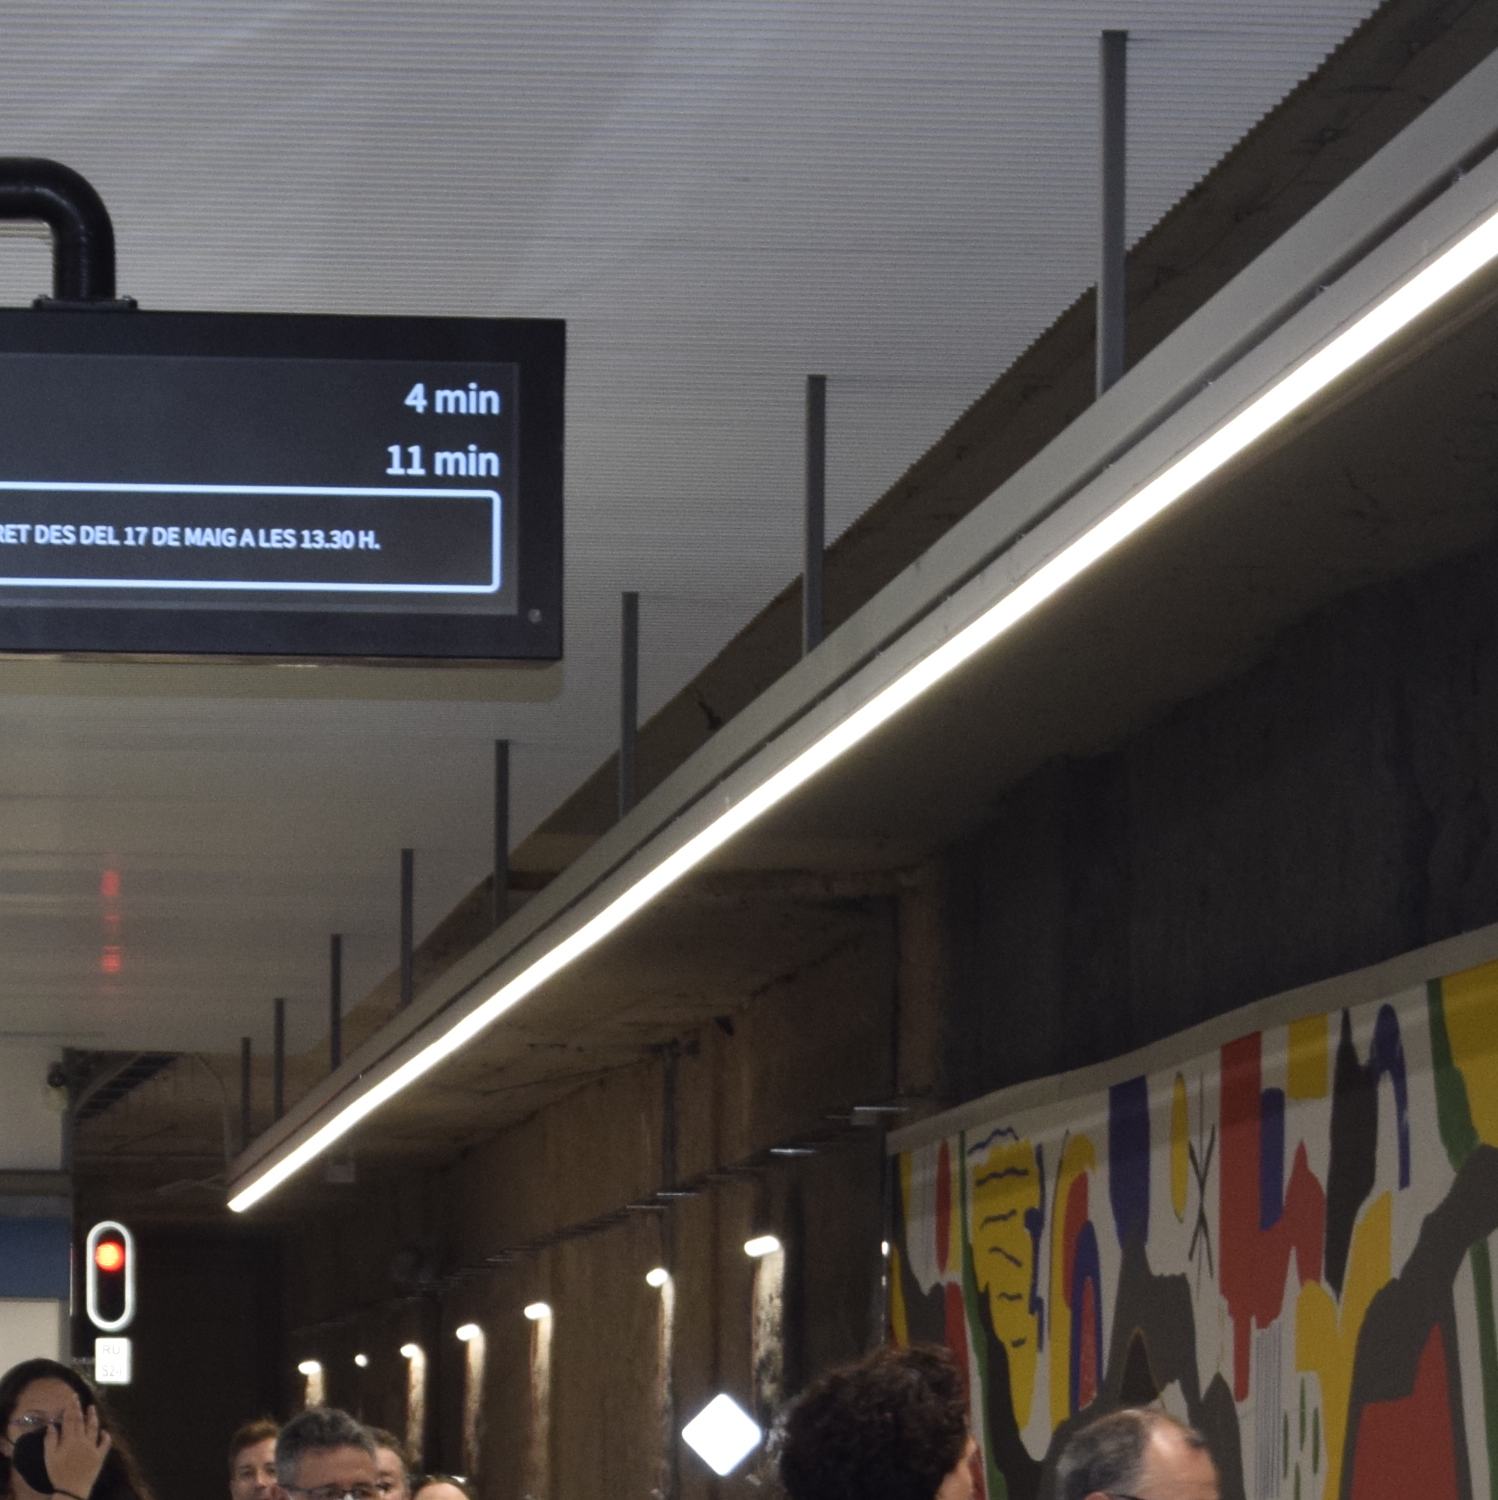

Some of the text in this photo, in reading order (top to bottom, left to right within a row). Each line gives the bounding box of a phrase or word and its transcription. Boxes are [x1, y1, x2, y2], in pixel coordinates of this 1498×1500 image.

[403, 381, 501, 415] 4 min
[385, 443, 501, 477] 11 min
[34, 524, 78, 546] DES
[80, 524, 120, 547] DEL
[123, 526, 149, 547] 17
[151, 526, 181, 548] DE
[184, 527, 238, 549] MAIG
[239, 528, 257, 548] A
[259, 528, 298, 550] LES
[300, 529, 355, 550] 13.30
[359, 530, 381, 550] H.
